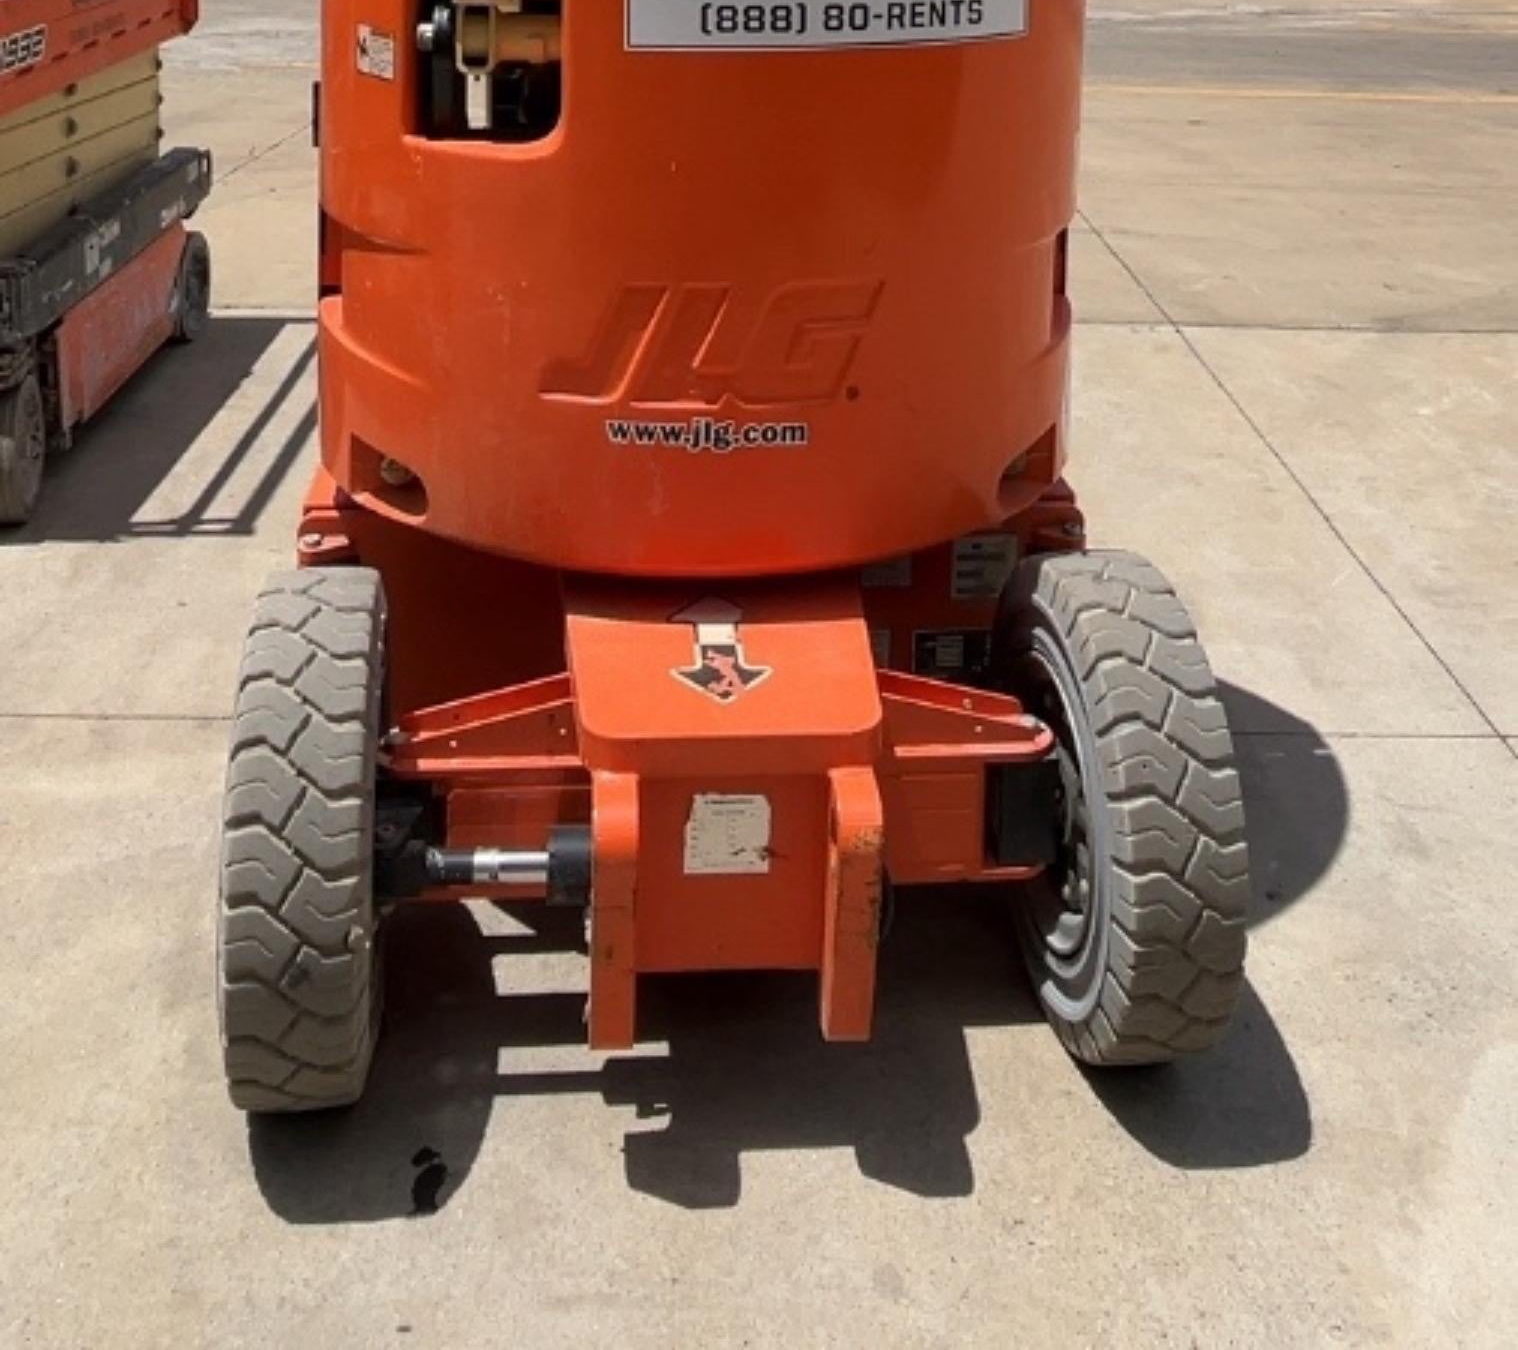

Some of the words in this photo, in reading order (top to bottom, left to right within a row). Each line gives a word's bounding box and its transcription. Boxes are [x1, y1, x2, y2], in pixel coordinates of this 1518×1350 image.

[700, 2, 808, 35] (888)
[537, 280, 886, 411] JLG
[606, 418, 808, 450] www.jlg.com
